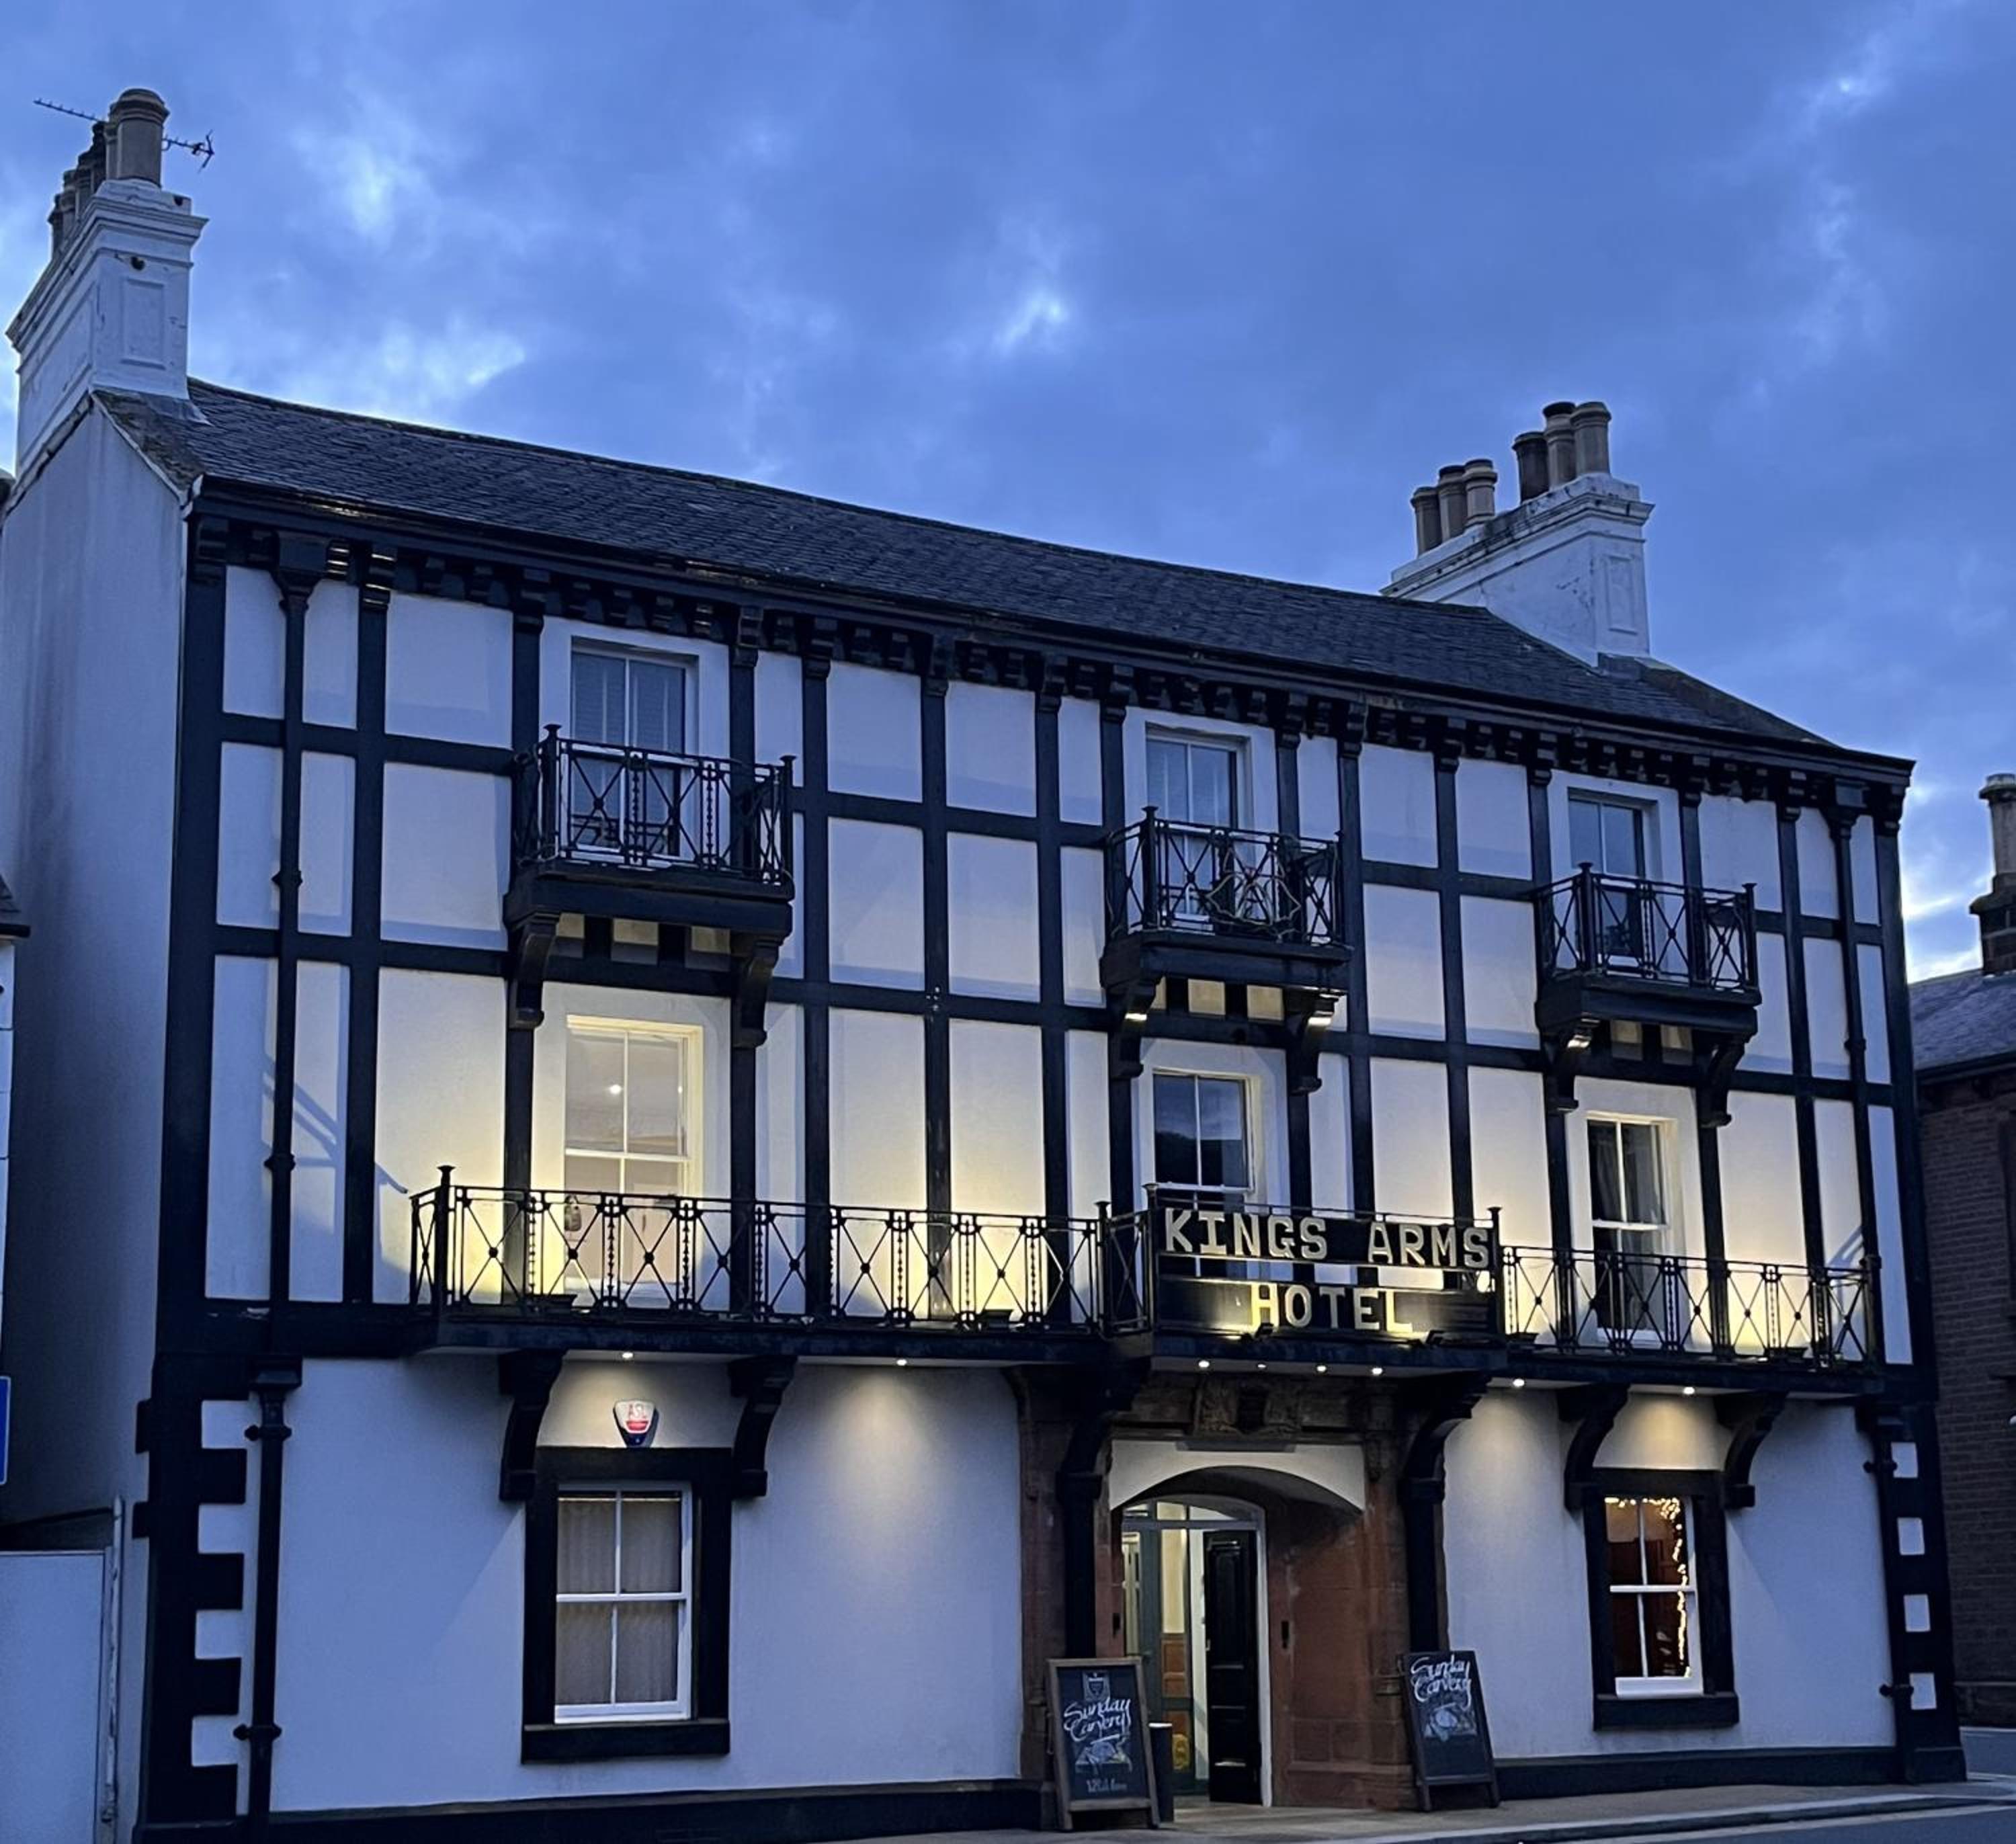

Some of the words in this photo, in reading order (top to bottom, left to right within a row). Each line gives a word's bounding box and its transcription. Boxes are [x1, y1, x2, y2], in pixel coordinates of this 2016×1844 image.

[1165, 1208, 1328, 1260] KINGS
[1368, 1222, 1488, 1268] ARMS
[1251, 1282, 1413, 1332] HOTEL
[1411, 1654, 1471, 1681] Sunday
[1064, 1697, 1131, 1724] Sunday
